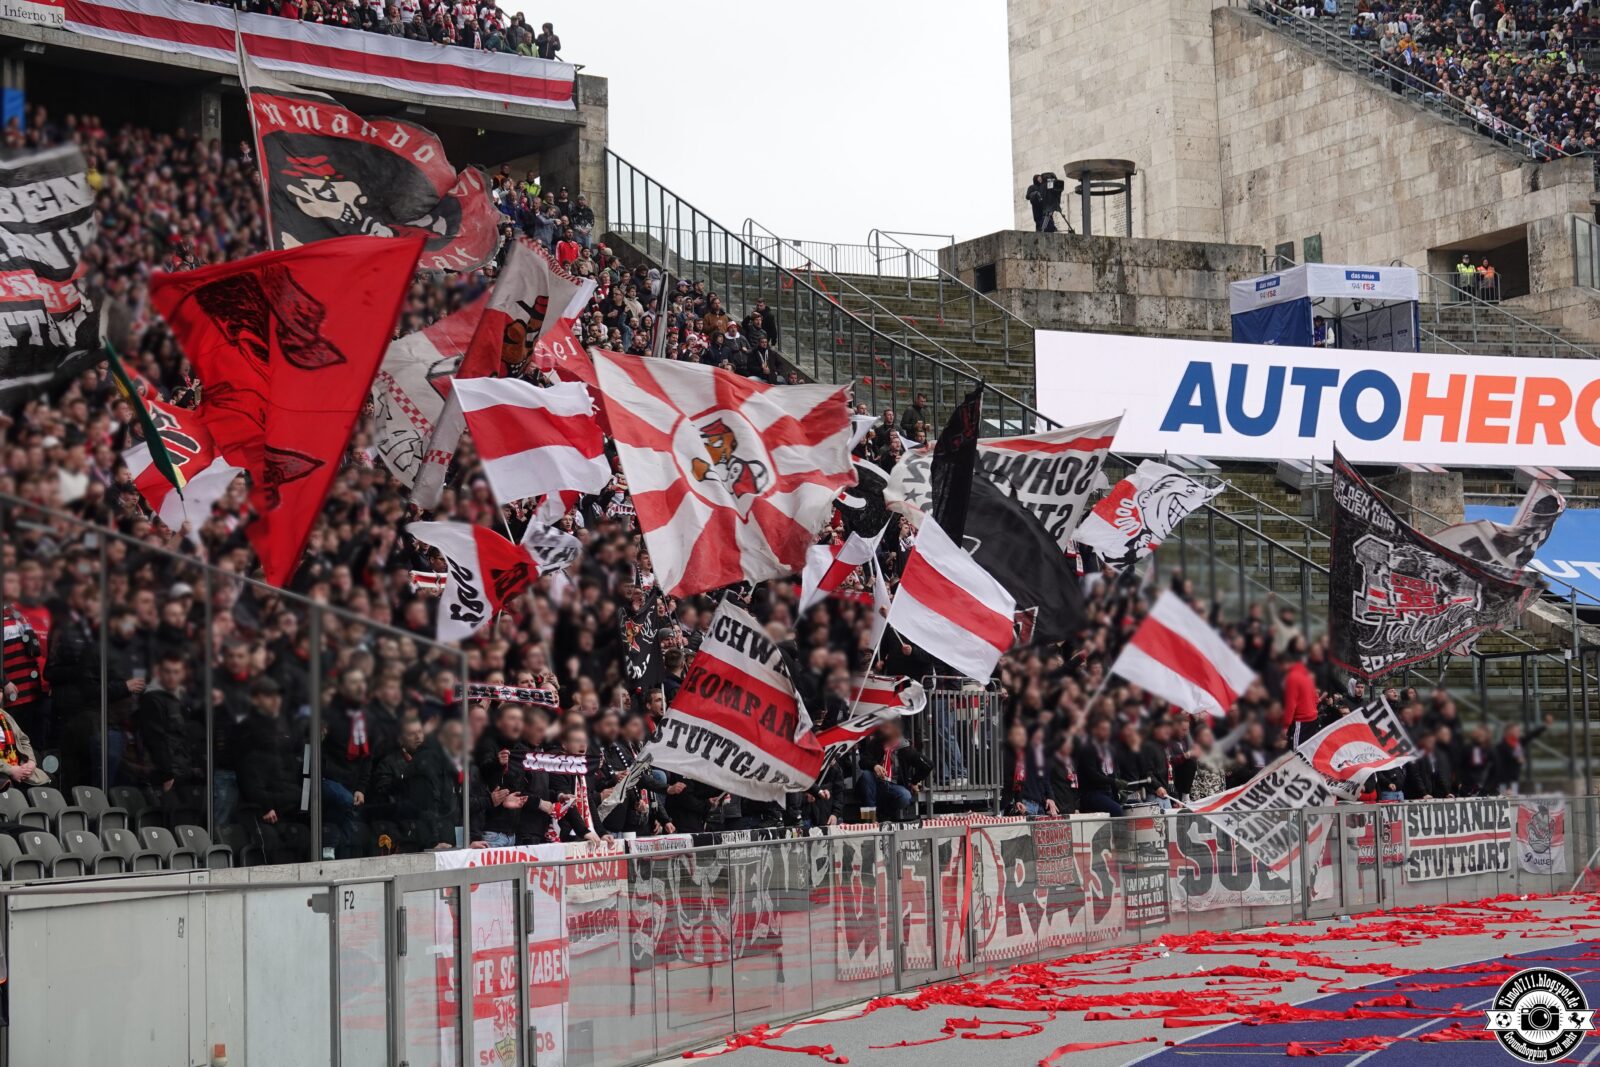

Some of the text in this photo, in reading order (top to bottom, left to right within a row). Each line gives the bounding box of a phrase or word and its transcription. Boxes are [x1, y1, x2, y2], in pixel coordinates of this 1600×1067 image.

[4, 5, 46, 22] Inferno
[684, 666, 798, 743] KOMPAN
[1407, 841, 1511, 878] STUTTGART
[344, 890, 355, 910] F2
